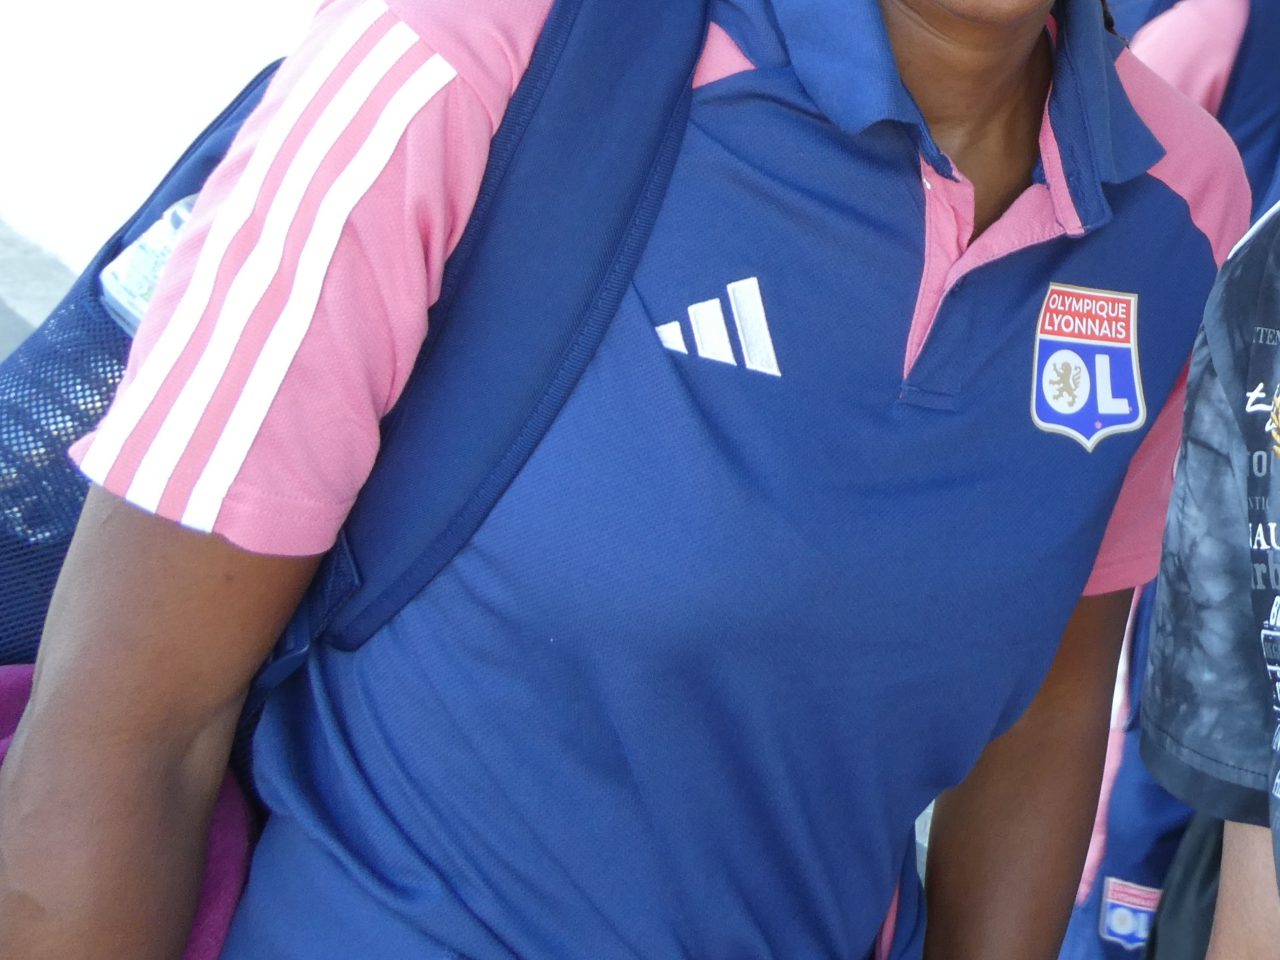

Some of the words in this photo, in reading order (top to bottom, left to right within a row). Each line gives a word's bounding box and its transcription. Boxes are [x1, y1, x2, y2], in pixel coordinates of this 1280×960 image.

[1049, 294, 1127, 319] OLYMPIQUE
[1044, 312, 1127, 339] LYONNAIS
[1042, 349, 1131, 415] OL
